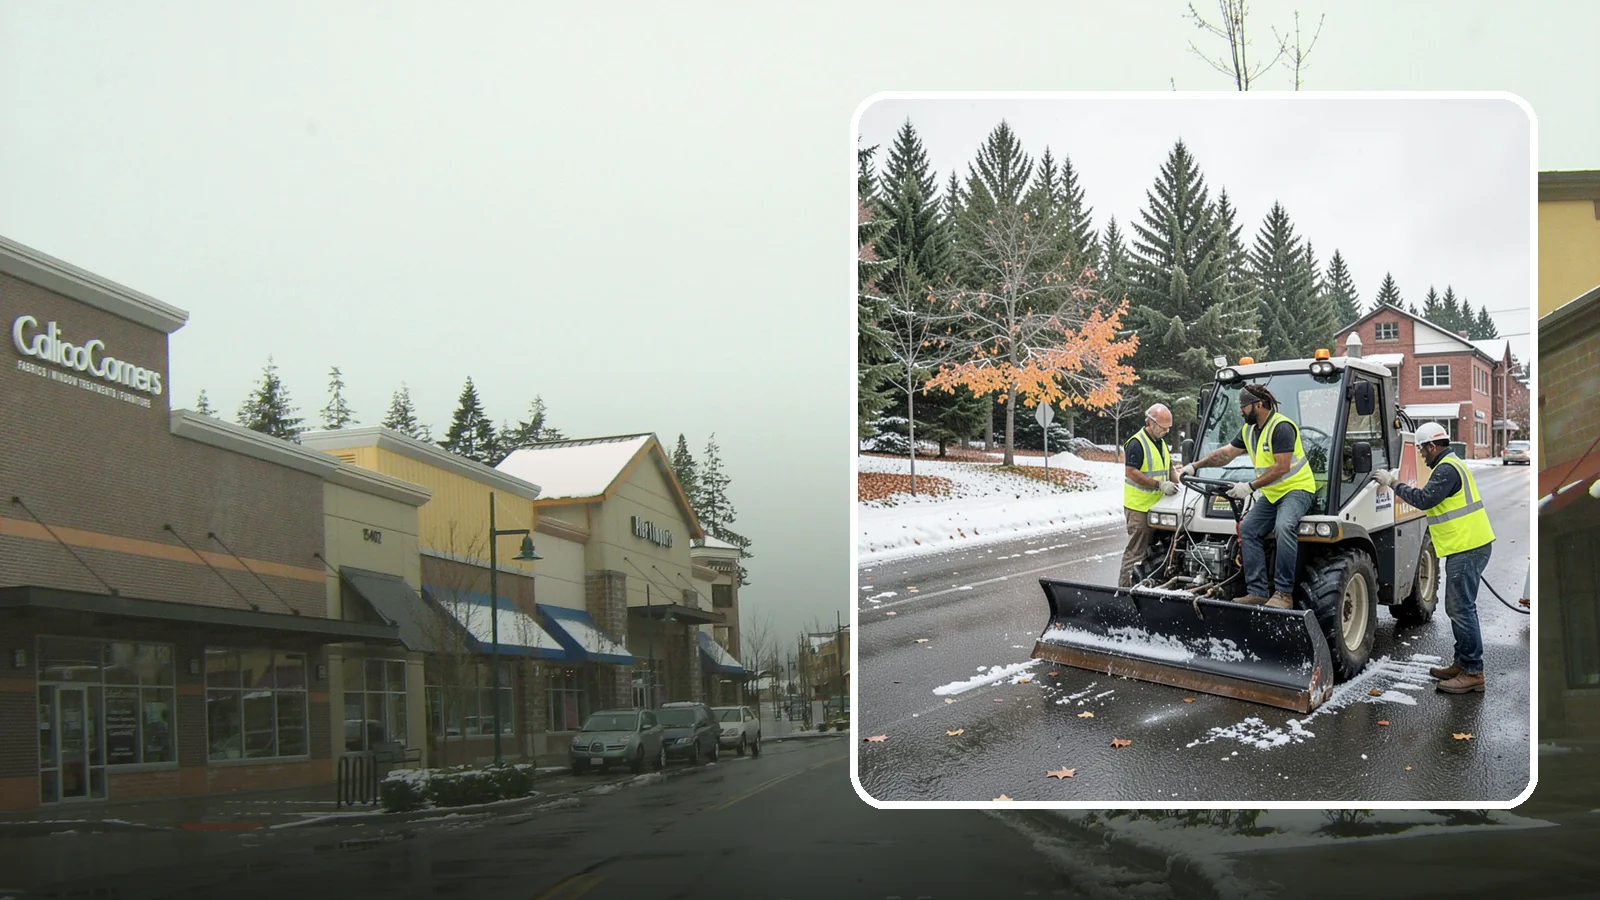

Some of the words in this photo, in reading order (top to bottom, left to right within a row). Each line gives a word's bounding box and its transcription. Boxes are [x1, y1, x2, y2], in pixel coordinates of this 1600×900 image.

[17, 360, 47, 377] FABRICS
[51, 371, 78, 387] WINDOW
[78, 378, 117, 398] TREATMENTS
[120, 391, 152, 409] FURNITURE
